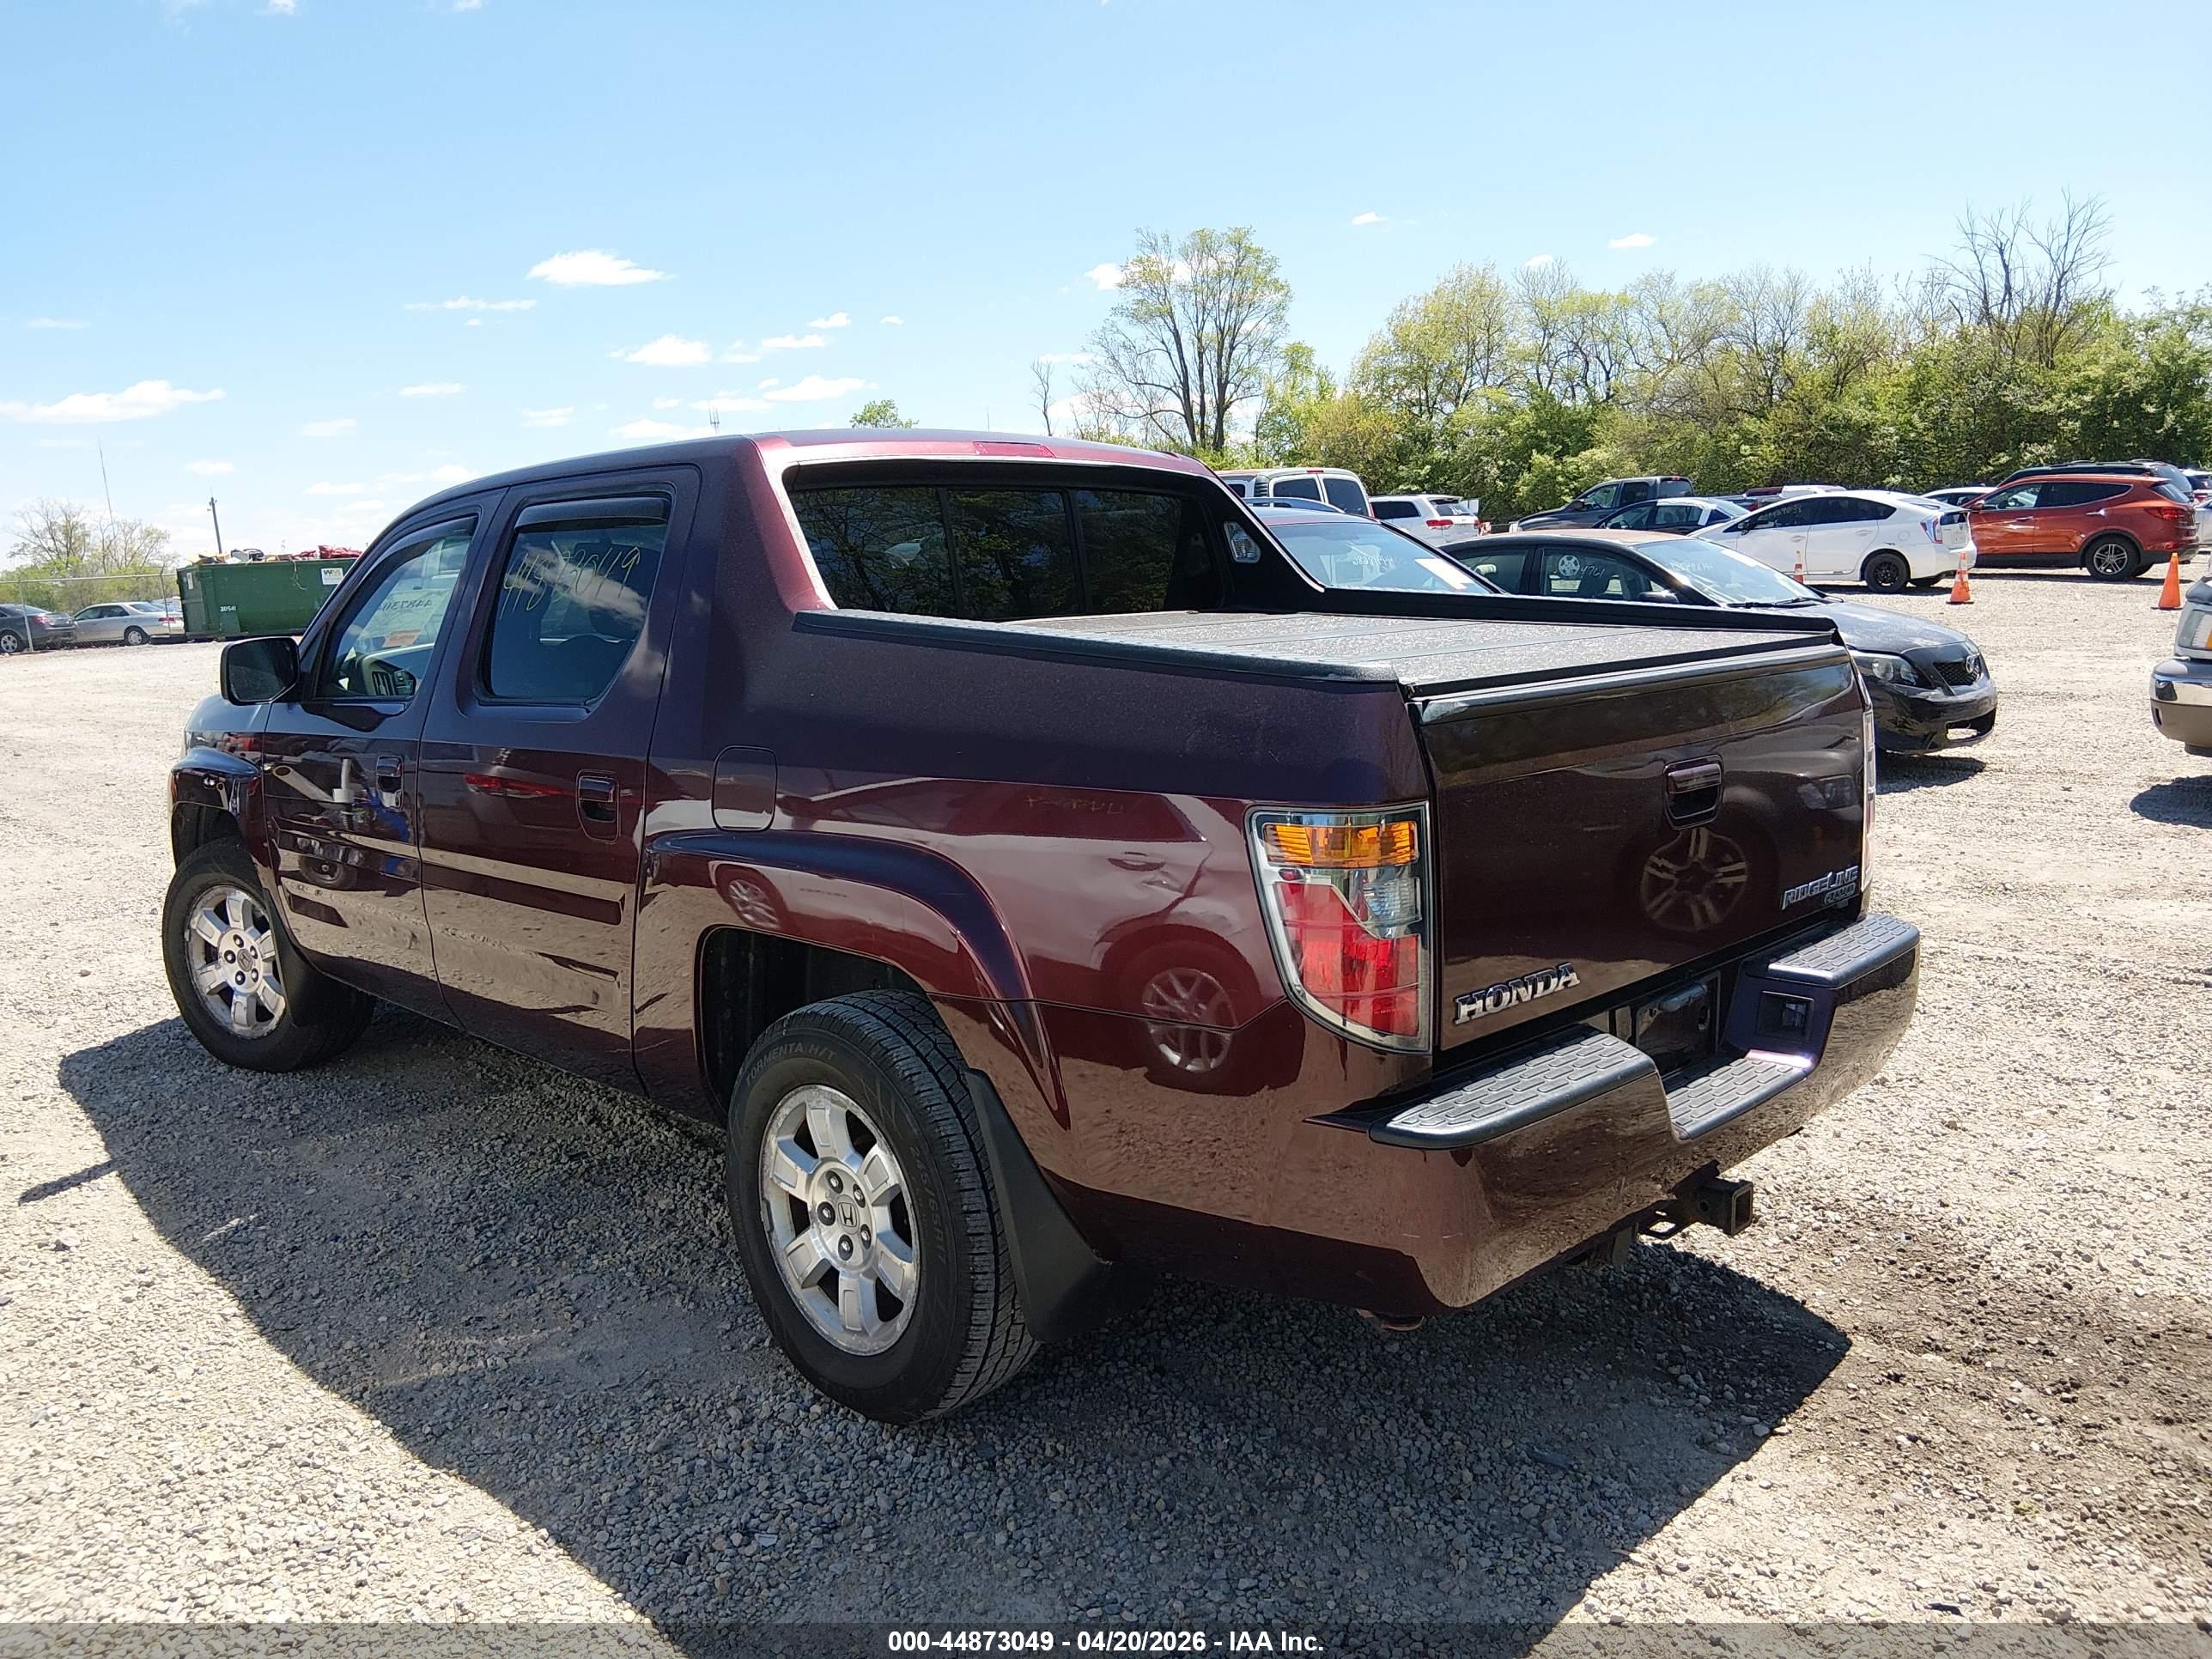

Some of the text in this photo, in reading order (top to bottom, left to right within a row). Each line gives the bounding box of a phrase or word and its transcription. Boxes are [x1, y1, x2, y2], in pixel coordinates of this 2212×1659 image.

[1781, 865, 1859, 910] RIDGELINE
[1454, 962, 1581, 1024] HONDA
[744, 1042, 838, 1086] TORMENTA H/T
